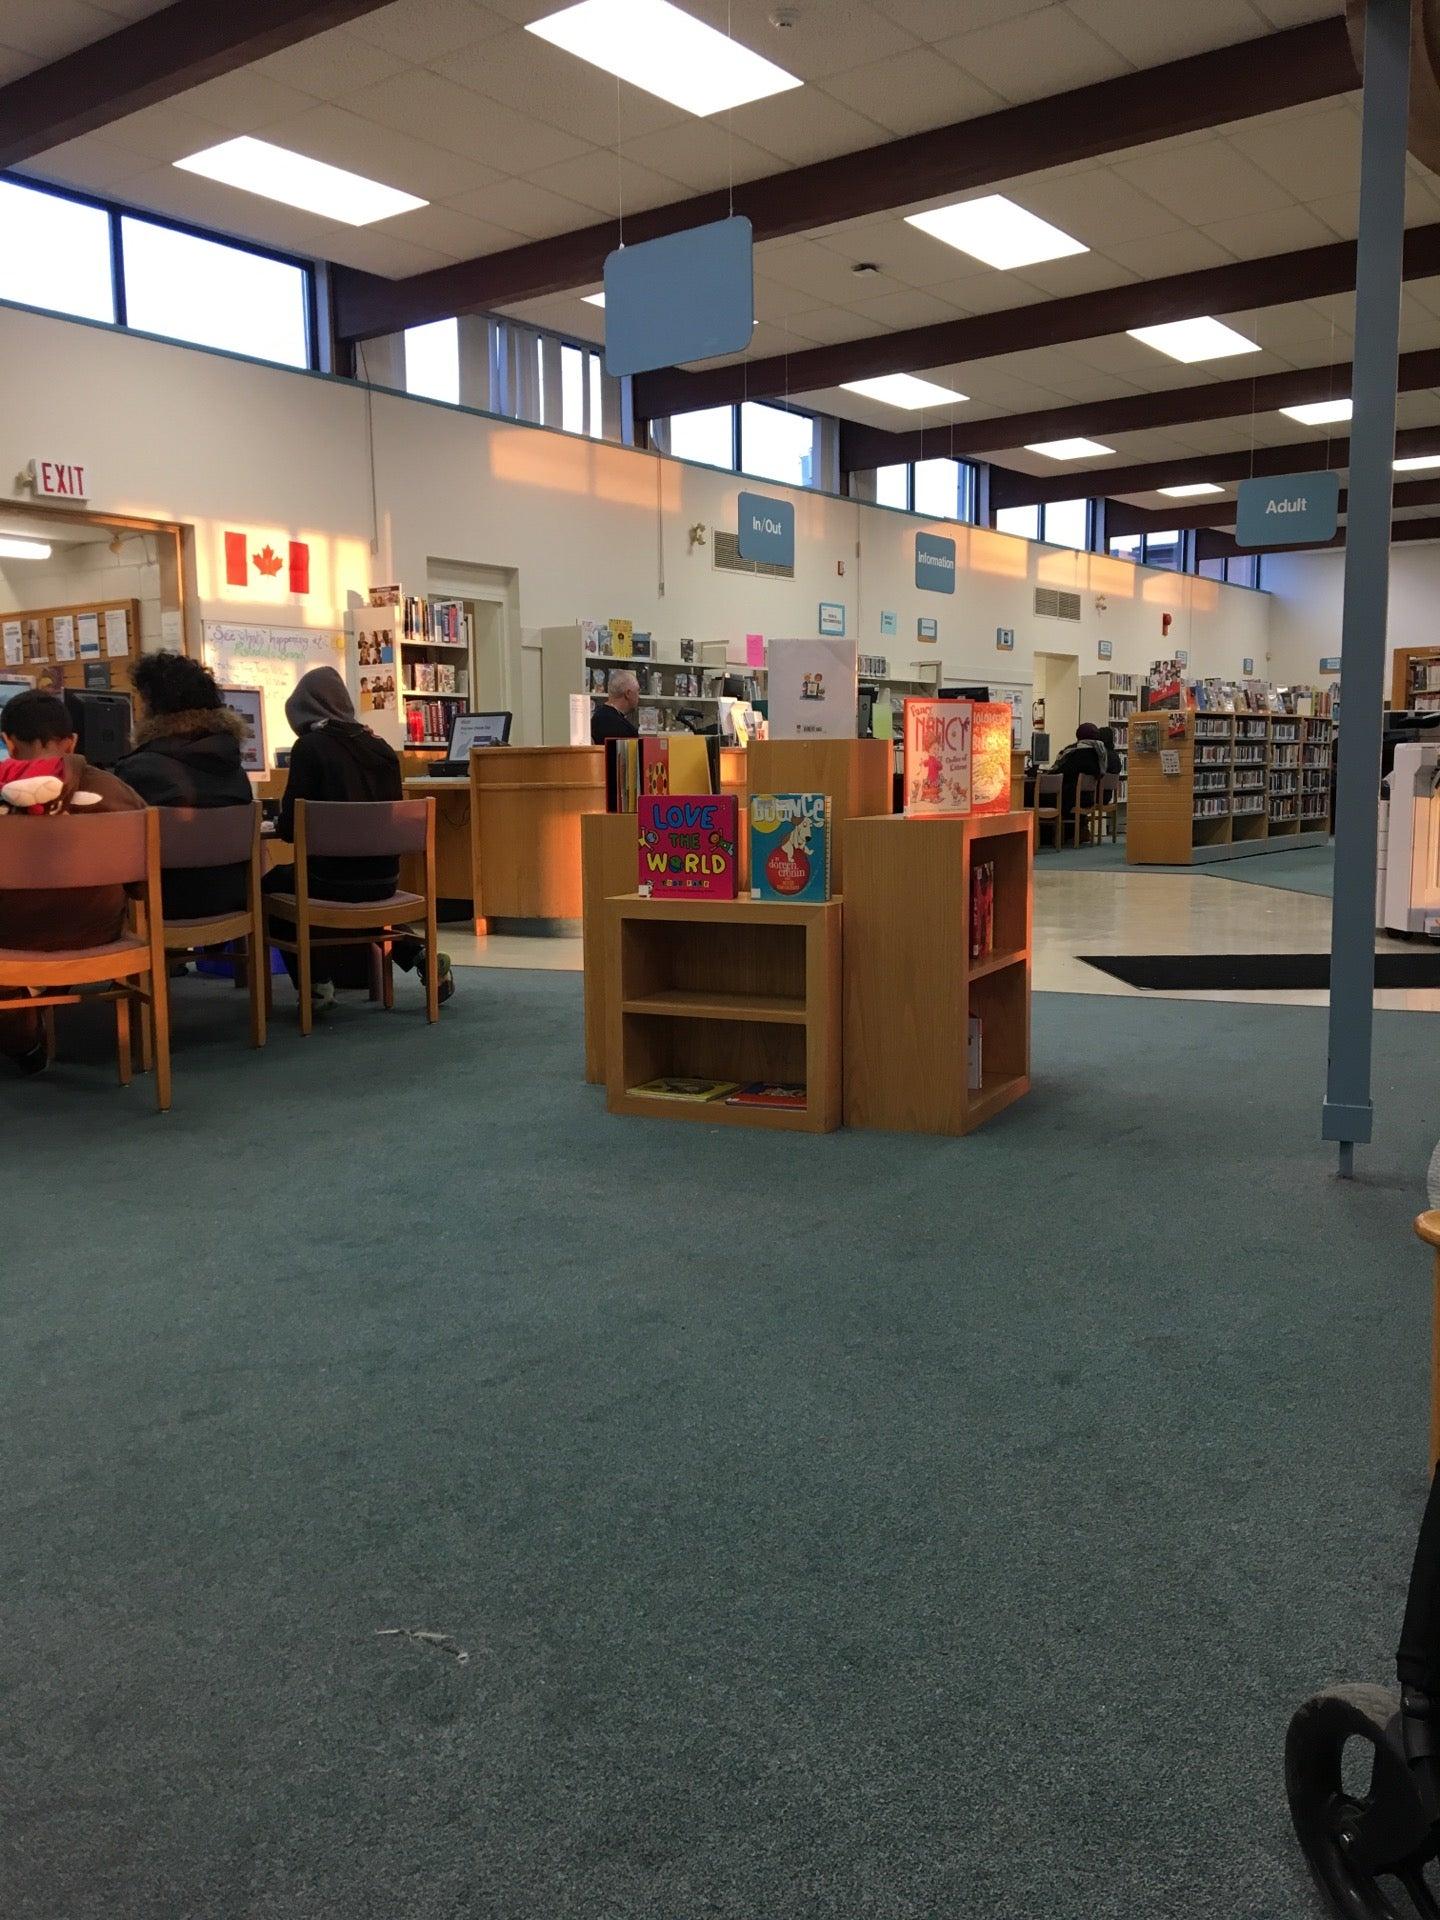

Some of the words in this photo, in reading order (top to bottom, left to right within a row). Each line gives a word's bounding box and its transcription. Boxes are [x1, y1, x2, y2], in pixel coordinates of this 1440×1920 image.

[41, 462, 84, 496] EXIT
[1265, 498, 1308, 514] Adult
[752, 516, 782, 536] In/Out
[918, 550, 954, 570] Information
[213, 625, 235, 643] See
[915, 716, 970, 752] NANCY
[652, 802, 718, 830] LOVE
[668, 832, 701, 850] THE
[646, 852, 726, 875] WORLD
